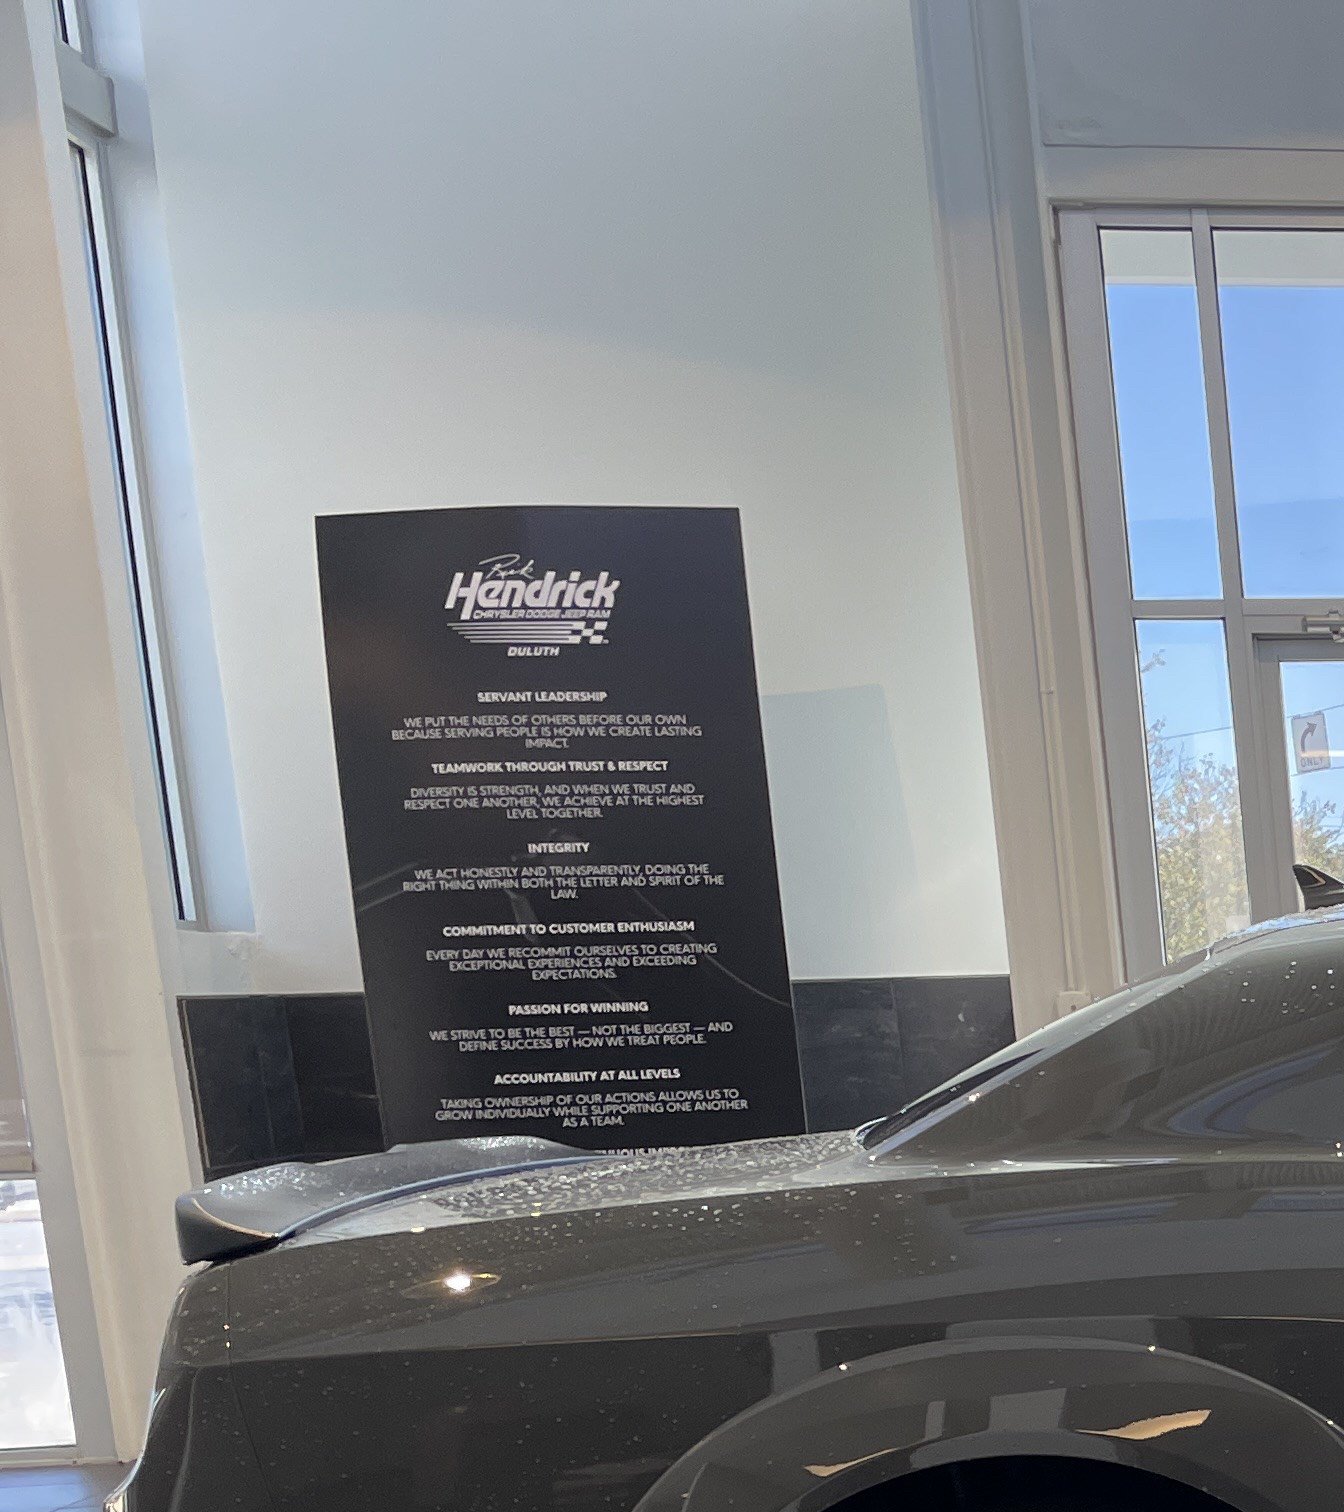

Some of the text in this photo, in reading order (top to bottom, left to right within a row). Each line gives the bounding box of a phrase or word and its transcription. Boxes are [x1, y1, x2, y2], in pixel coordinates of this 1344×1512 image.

[445, 571, 620, 620] Hendrick
[473, 609, 611, 619] CHRYSLER DODGE JEEP RAM
[507, 647, 559, 655] DULUTH
[477, 692, 606, 701] SERVANT LEADERSHIP
[403, 715, 685, 726] WE PUT THE NEEDS OF OTHERS BEFORE OUR OWN
[391, 727, 701, 739] BECAUSE SERVING PEOPLE IS HOW WE CREATE LASTING
[431, 761, 667, 773] TEAMWORK THROUGH TRUST & RESPECT
[410, 787, 464, 797] DIVERSITY
[467, 786, 477, 796] IS
[544, 785, 569, 795] AND
[572, 785, 608, 795] WHEN
[611, 785, 629, 795] WE
[634, 784, 665, 794] TRUST
[669, 784, 694, 794] AND
[404, 799, 449, 809] RESPECT
[453, 798, 478, 808] ONE
[541, 797, 560, 807] WE
[563, 796, 612, 807] ACHIEVE
[616, 796, 628, 806] AT
[632, 796, 653, 806] THE
[656, 795, 703, 805] HIGHEST
[528, 843, 589, 853] INTEGRITY
[414, 869, 432, 879] WE
[435, 868, 456, 878] ACT
[460, 867, 517, 878] HONESTLY
[521, 867, 546, 877] AND
[645, 865, 685, 875] DOING
[689, 865, 708, 875] THE
[402, 875, 723, 890] RIGHT THING WITHIN BOTH THE LETTER AND SPIRIT OF THE
[442, 921, 694, 936] COMMITMENT TO CUSTOMER ENTHUSIASM
[426, 943, 716, 960] EVERY DAY WE RECOMMIT OURSELVES TO CREATING
[449, 955, 696, 971] EXCEPTIONAL EXPERIENCES AND EXCEEDING
[508, 1002, 648, 1015] PASSION FOR WINNING
[429, 1022, 732, 1040] WE STRIVE TO BE THE BEST NOT THE BIGGEST AND
[459, 1040, 498, 1050] DEFINE
[500, 1038, 552, 1049] SUCCESS
[555, 1038, 569, 1048] BY
[572, 1037, 603, 1047] HOW
[605, 1036, 624, 1047] WE
[627, 1035, 659, 1046] TREAT
[494, 1069, 680, 1084] ACCOUNTABILITY AT ALL LEVELS
[440, 1089, 738, 1109] TAKING OWNERSHIP OF OUR ACTIONS ALLOWS US TO
[435, 1099, 747, 1120] GROW INDIVIDUALLY WHILE SUPPORTING ONE ANOTHER
